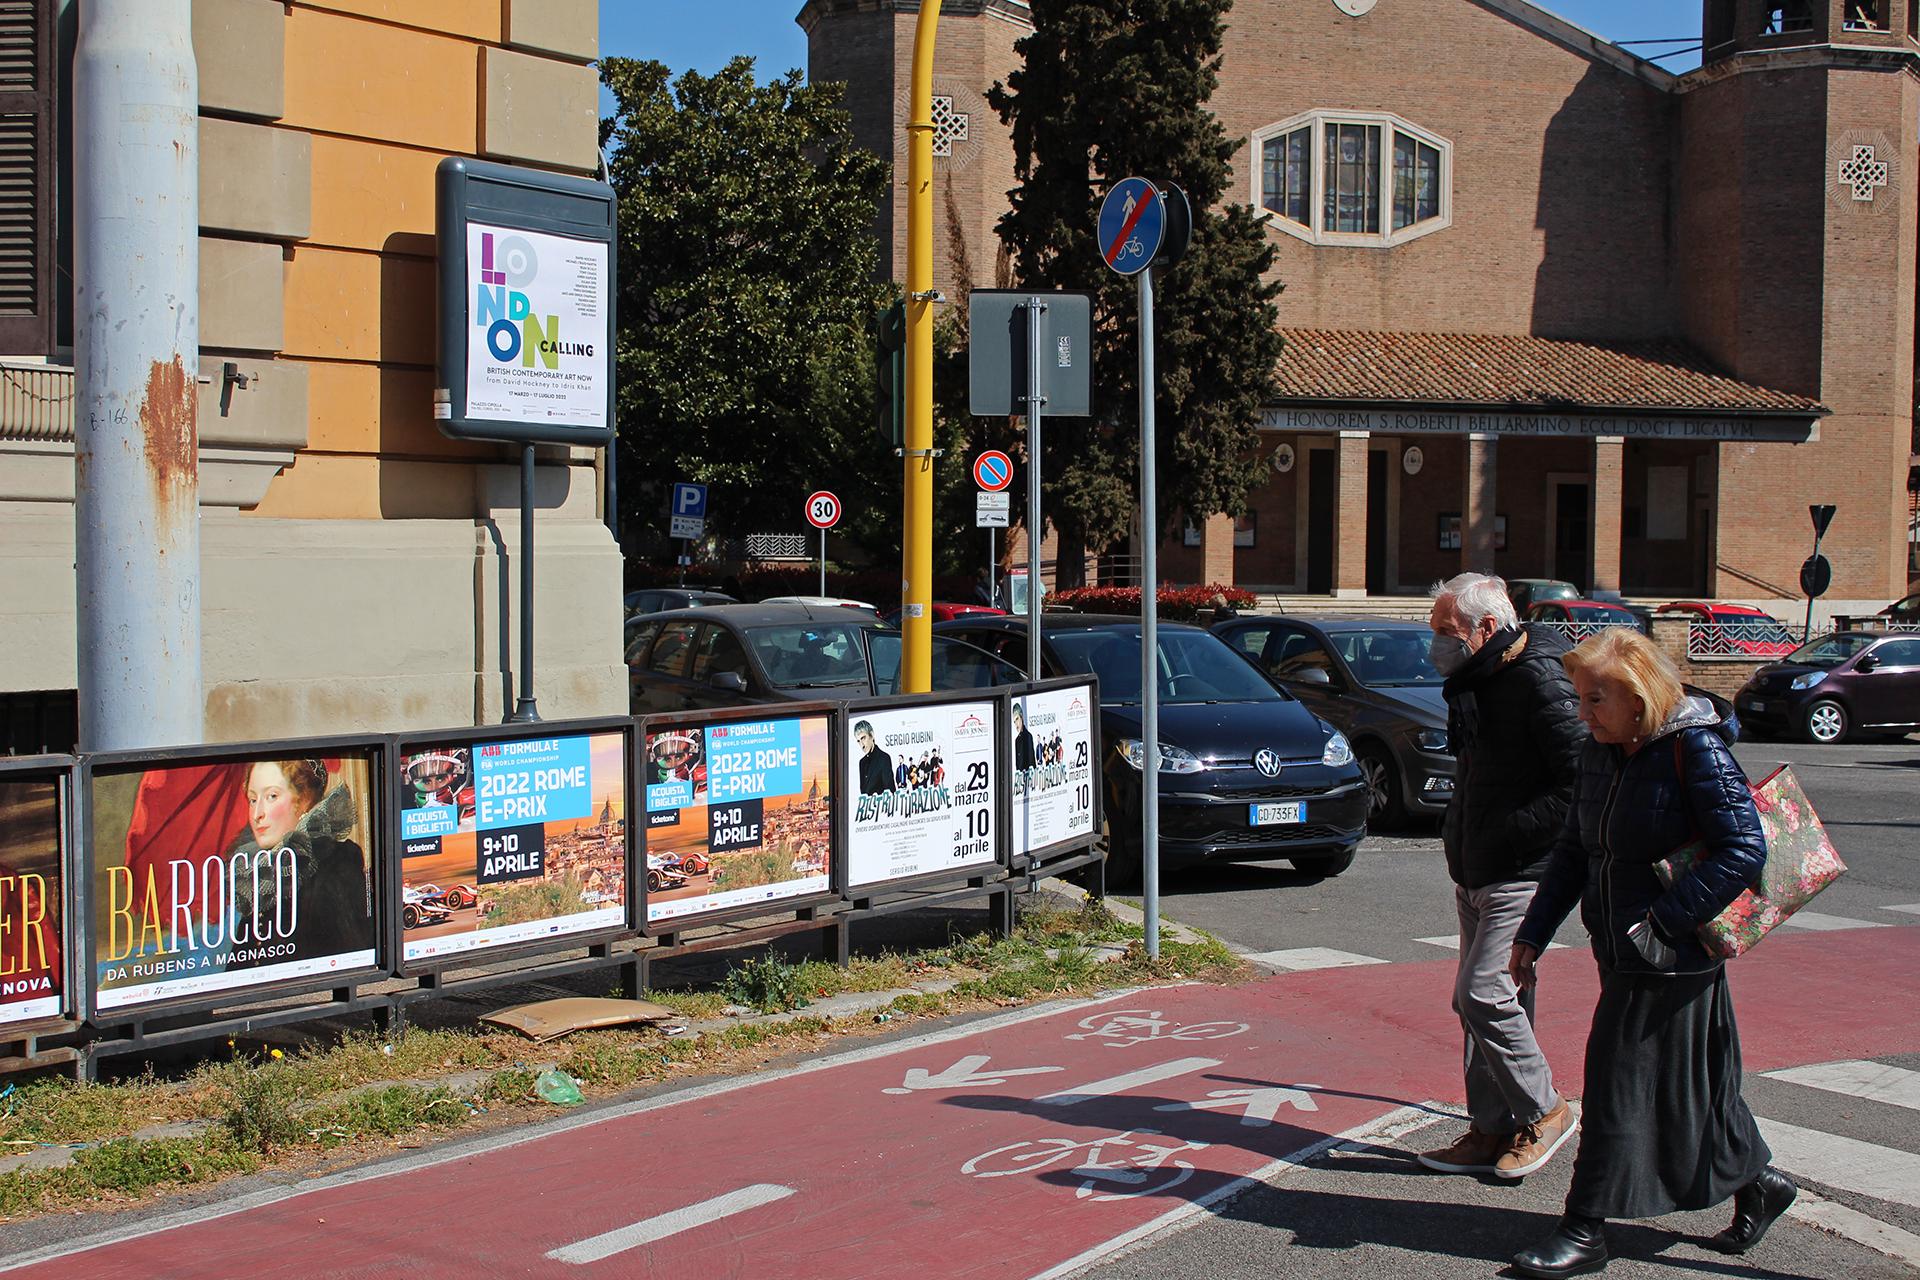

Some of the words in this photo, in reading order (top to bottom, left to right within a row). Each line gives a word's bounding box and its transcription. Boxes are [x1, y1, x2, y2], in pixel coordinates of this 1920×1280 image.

[540, 340, 594, 357] CALLING
[487, 367, 510, 376] BRITISH
[512, 369, 563, 380] CONTEMPORARY
[565, 373, 576, 381] ART
[487, 376, 501, 384] from
[503, 378, 520, 386] David
[523, 380, 549, 389] Hockney
[561, 382, 575, 390] Idris
[1286, 412, 1370, 428] HONOREM
[1469, 415, 1571, 433] BELLARMINO
[680, 487, 701, 513] P
[814, 501, 834, 519] 30
[712, 728, 728, 738] ABB
[730, 724, 768, 737] FORMULA
[769, 723, 775, 733] E
[885, 733, 910, 747] SERGIO
[911, 730, 934, 745] RUBINI
[481, 745, 501, 757] ABB
[504, 742, 552, 755] FORMULA
[553, 740, 559, 751] E
[1076, 740, 1088, 768] 29
[516, 755, 559, 764] CHAMPIONSHIP
[711, 752, 752, 775] 2022
[755, 747, 797, 770] ROME
[481, 771, 530, 798] 2022
[534, 765, 586, 792] ROME
[711, 772, 766, 798] E-PRIX
[955, 782, 967, 794] dal
[967, 761, 989, 792] 29
[1069, 768, 1088, 782] marzo
[651, 785, 685, 798] ACQUISTA
[655, 795, 689, 807] BIGLIETTI
[955, 790, 989, 807] marzo
[1076, 784, 1089, 811] 10
[406, 810, 448, 824] ACQUISTA
[481, 794, 548, 823] E-PRIX
[713, 808, 742, 827] 9+10
[411, 821, 453, 835] BIGLIETTI
[953, 829, 962, 842] al
[966, 808, 989, 839] 10
[1069, 812, 1089, 829] aprile
[483, 834, 518, 856] 9+10
[713, 824, 758, 846] APRILE
[953, 839, 989, 859] aprile
[483, 852, 540, 876] APRILE
[106, 846, 297, 962] BAROCCO
[107, 967, 128, 981] DA
[133, 957, 196, 977] RUBENS
[200, 956, 211, 968] A
[215, 943, 296, 966] MAGNASCO
[0, 976, 52, 996] NOVA
